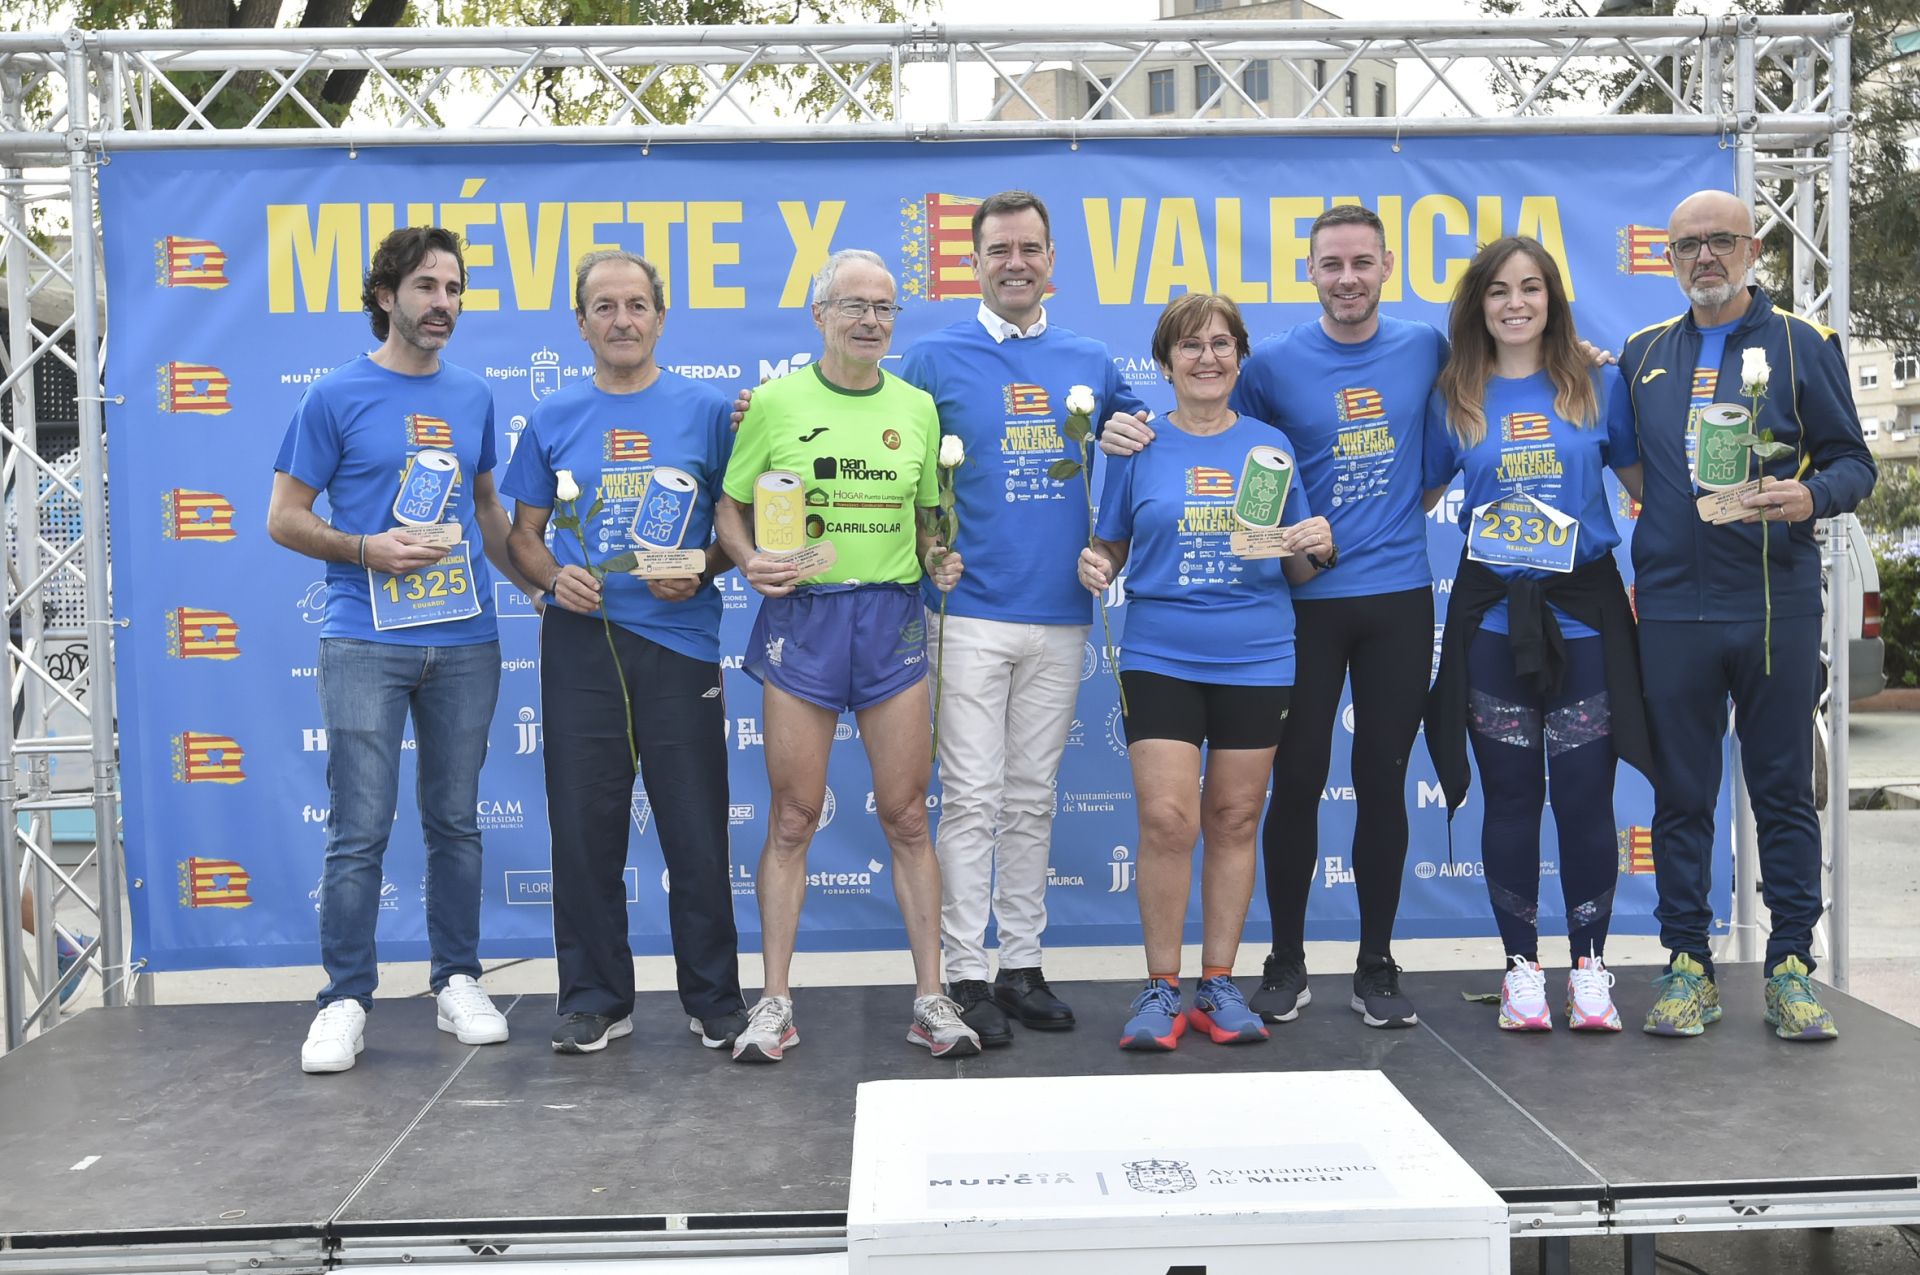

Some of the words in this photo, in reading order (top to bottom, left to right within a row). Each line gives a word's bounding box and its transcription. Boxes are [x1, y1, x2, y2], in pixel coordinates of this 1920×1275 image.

[778, 201, 845, 309] X
[1113, 357, 1157, 371] CAM
[485, 366, 527, 379] Región
[563, 366, 579, 376] de
[668, 364, 742, 379] VERDAD
[1121, 372, 1158, 380] RSIDAD
[281, 374, 321, 384] MUR
[1000, 438, 1009, 451] X
[1010, 436, 1064, 451] VALENCIA
[1332, 445, 1340, 458] X
[1343, 436, 1395, 456] VALENCIA
[840, 458, 866, 471] pan
[1501, 448, 1556, 467] MUÉVETE
[843, 469, 897, 481] moreno
[1496, 467, 1504, 479] X
[1507, 461, 1563, 479] VALENCIA
[602, 470, 650, 488] MUÉVET
[606, 484, 645, 499] VALEN
[833, 490, 864, 500] HOGAR
[1184, 503, 1234, 520] MUÉVET
[1177, 519, 1186, 532] X
[1479, 511, 1568, 546] 2330
[1506, 543, 1533, 553] REBECA
[382, 568, 468, 604] 1325
[412, 600, 445, 609] EDUARDO
[509, 594, 532, 605] FLO
[501, 657, 535, 672] egión
[737, 733, 764, 750] pu
[1063, 790, 1132, 802] Ayuntamiento
[477, 800, 523, 815] CAM
[728, 806, 752, 818] DEZ
[1063, 802, 1075, 812] de
[1077, 802, 1115, 812] Murcia
[477, 815, 524, 825] IVERSIDAD
[806, 871, 871, 886] estreza
[1048, 876, 1084, 886] MURCIA
[1324, 868, 1356, 888] pul
[1206, 1164, 1377, 1178] Ayuntamiento
[930, 1177, 1075, 1187] MURCIA
[1209, 1176, 1239, 1186] de
[1248, 1173, 1344, 1185] Murcia
